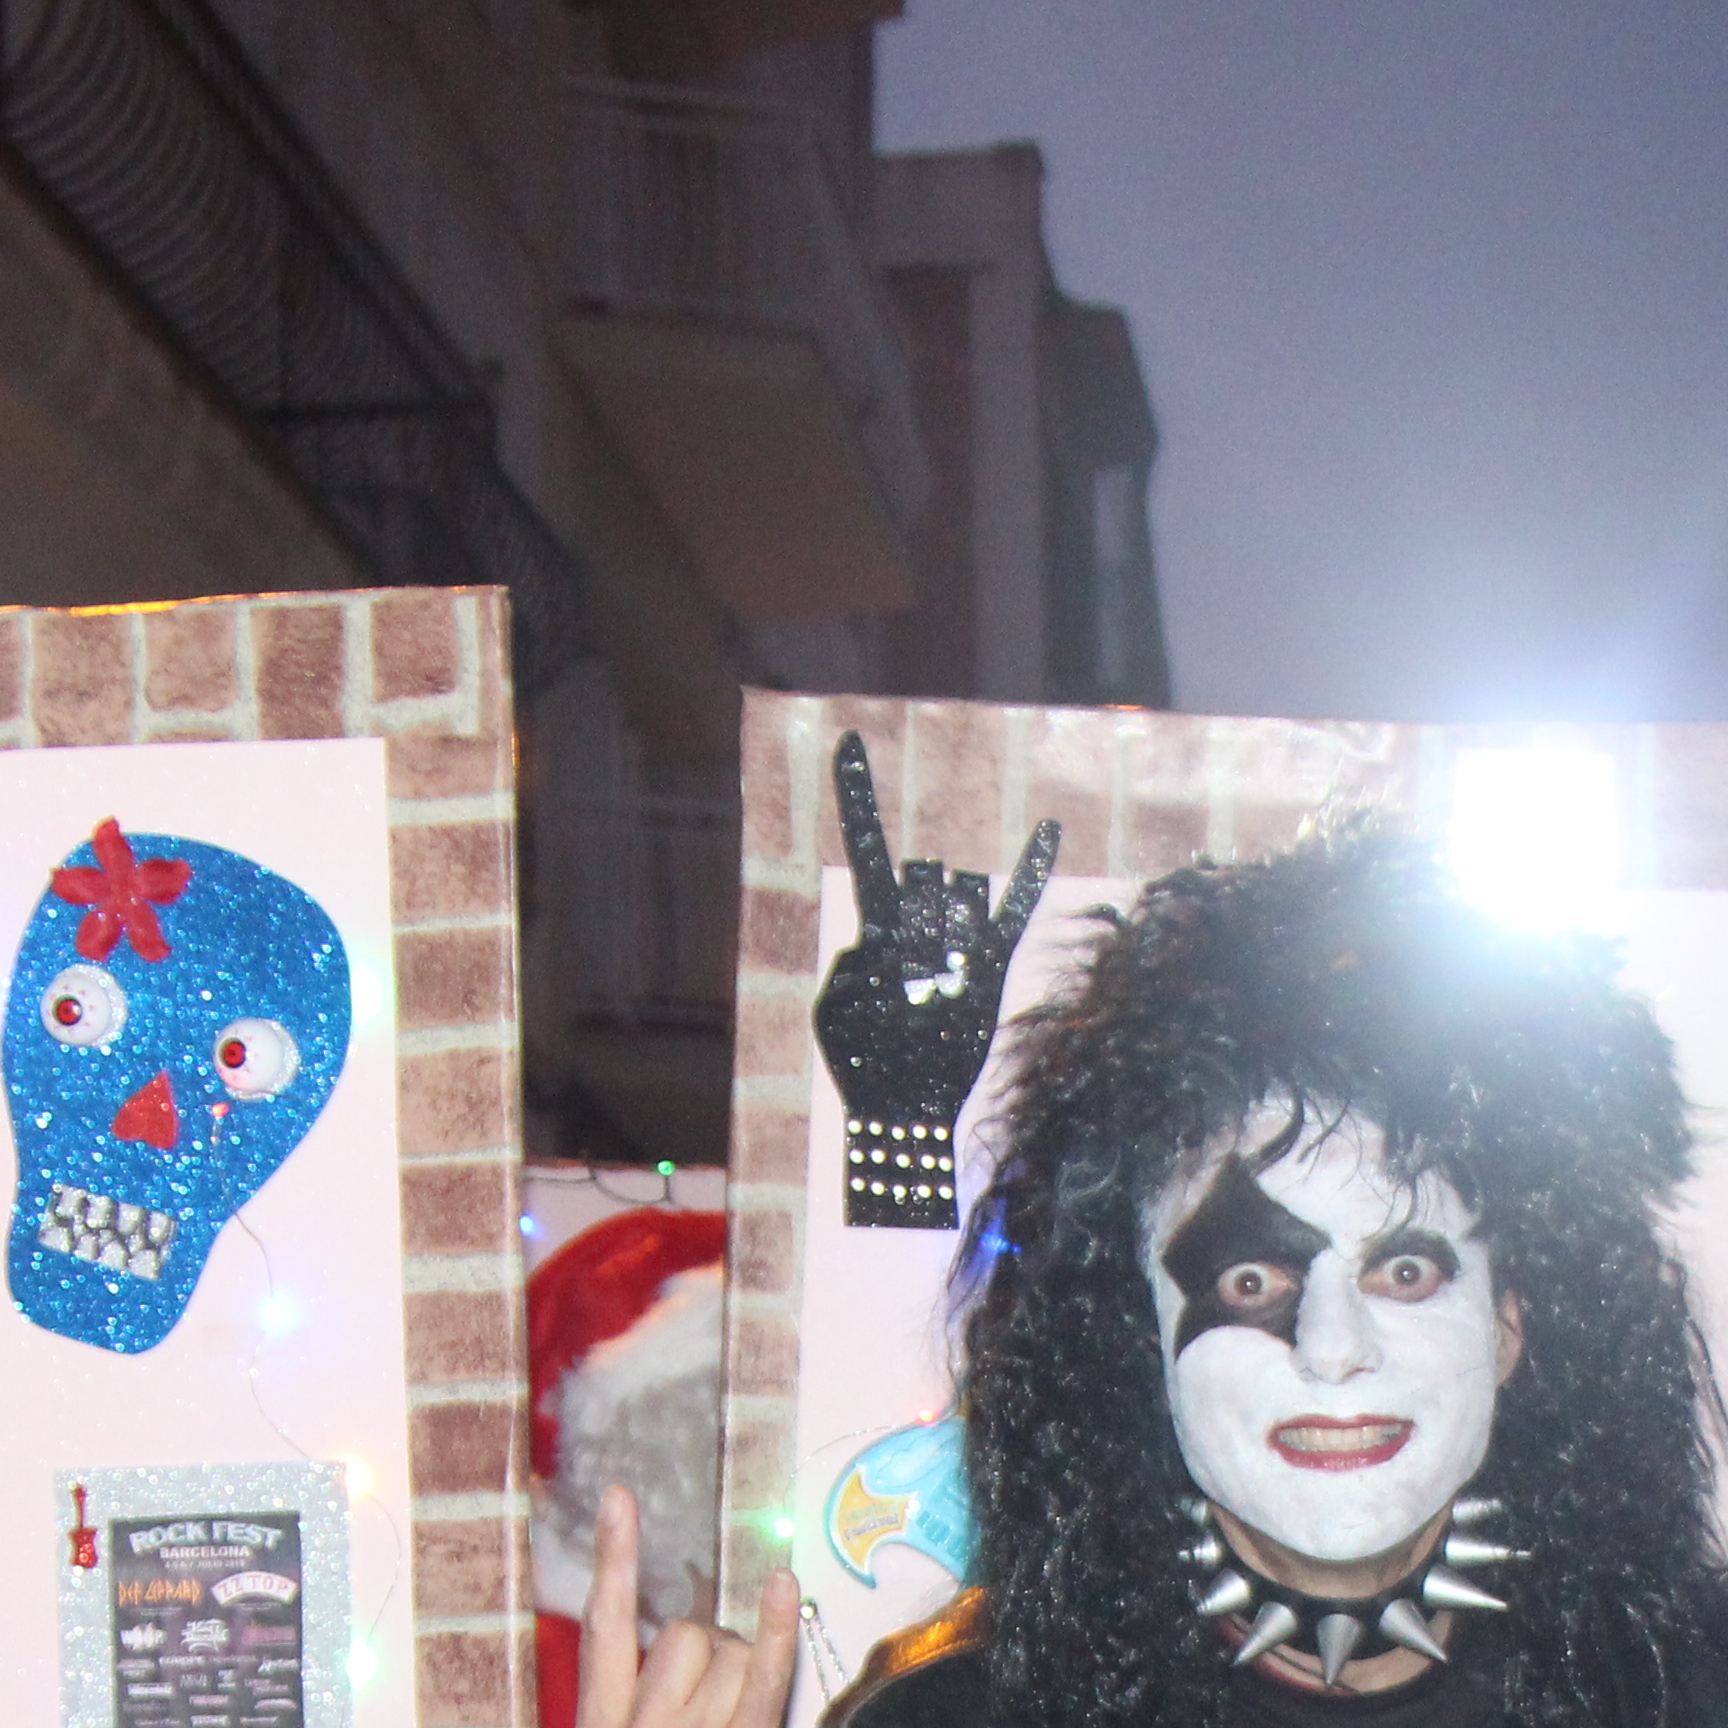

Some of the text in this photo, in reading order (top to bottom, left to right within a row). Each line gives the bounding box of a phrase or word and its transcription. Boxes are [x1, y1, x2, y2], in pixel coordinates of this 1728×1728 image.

[128, 1520, 284, 1556] ROCK FEST
[160, 1546, 250, 1559] BARCELONA
[249, 1575, 289, 1595] TOP
